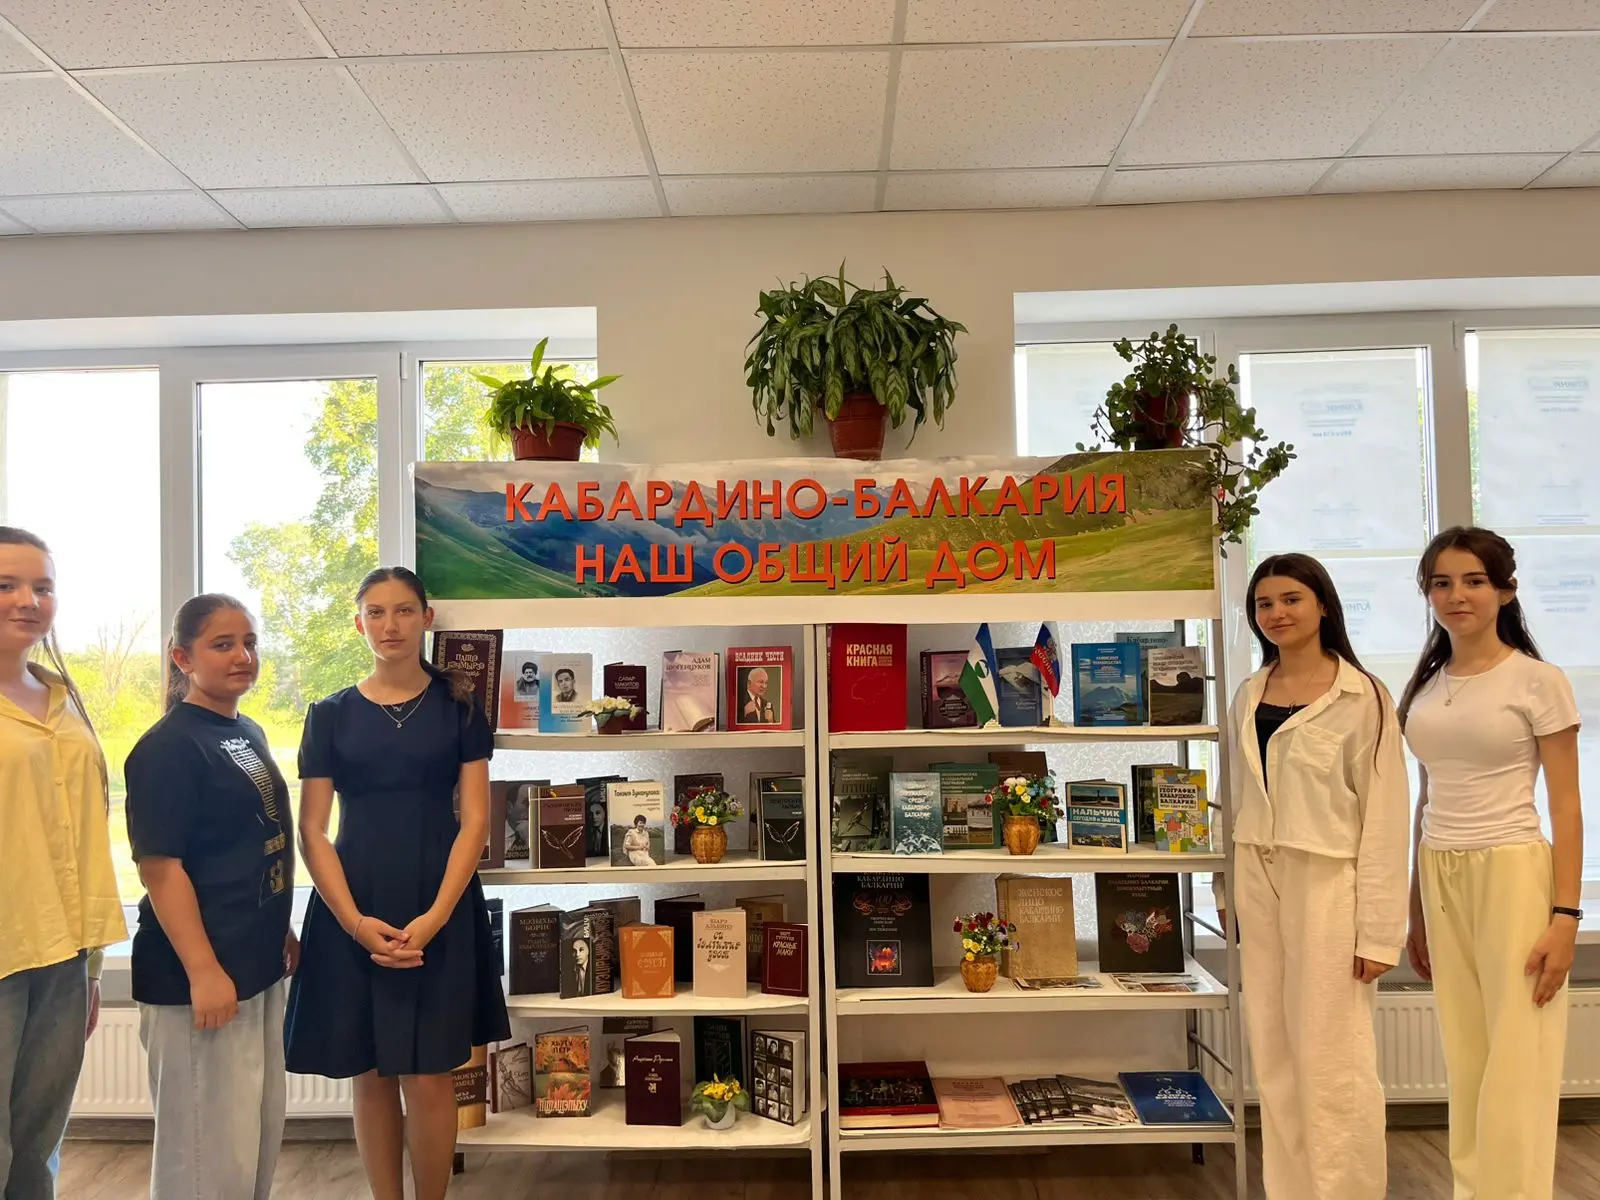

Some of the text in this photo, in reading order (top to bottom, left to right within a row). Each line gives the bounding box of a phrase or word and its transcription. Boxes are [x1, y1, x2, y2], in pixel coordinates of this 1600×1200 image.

[505, 473, 1126, 528] КАБАРДИНО-БАЛКАРИЯ
[575, 536, 1057, 590] НАШ ОБЩИЙ ДОМ
[846, 643, 893, 655] КРАСНАЯ
[735, 651, 785, 663] ВСАДНИК ЧЕСТИ
[846, 655, 878, 667] КНИГА
[1073, 808, 1120, 818] НАЛЬЧИК
[1018, 887, 1063, 897] ЖЕНСКОЕ
[1019, 897, 1044, 906] ЛИЦО
[1019, 905, 1064, 914] КАБАРДИНО
[1019, 914, 1061, 923] БАЛКАРИИ
